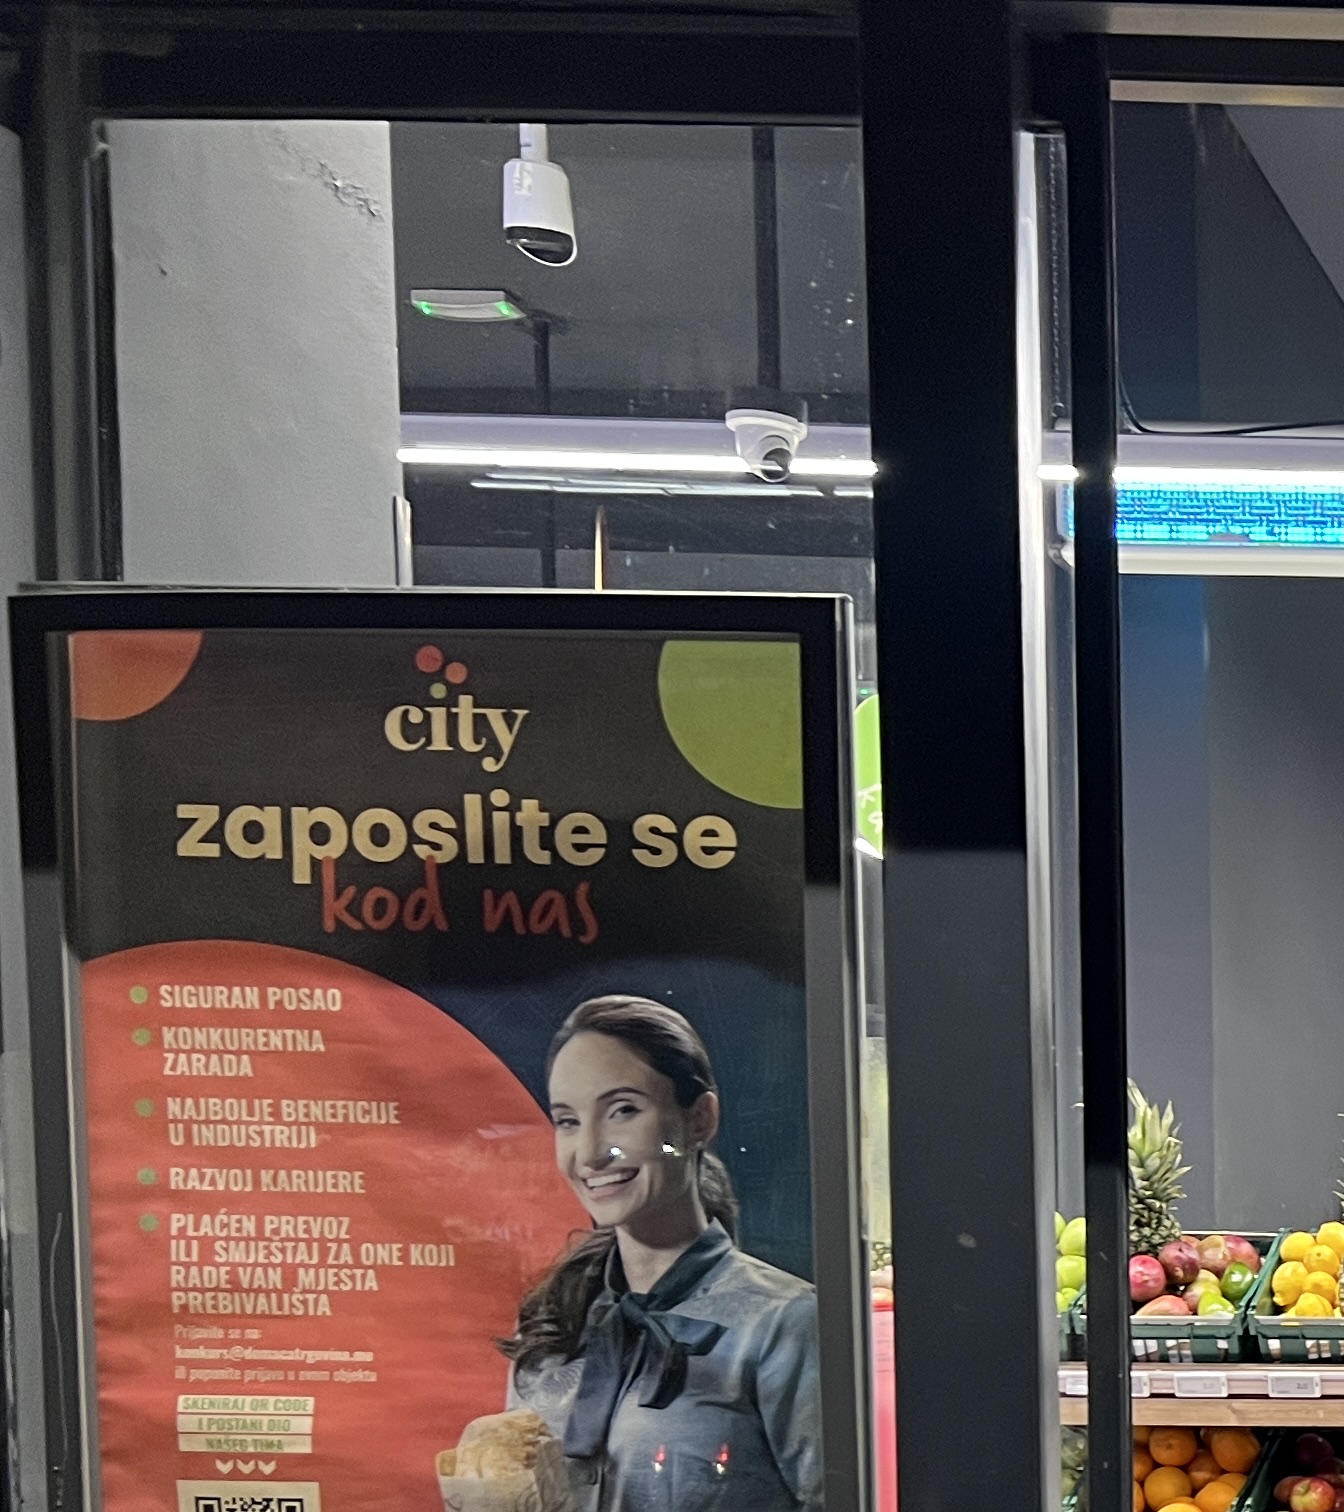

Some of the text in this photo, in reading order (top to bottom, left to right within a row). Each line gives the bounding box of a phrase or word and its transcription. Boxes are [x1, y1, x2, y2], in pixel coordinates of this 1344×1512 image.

[383, 688, 530, 772] city
[175, 790, 739, 885] zaposlite se
[321, 853, 600, 944] kod nas
[159, 984, 342, 1012] SIGURAN POSAO
[161, 1026, 325, 1053] KONKURENTNA
[162, 1052, 254, 1078] ZARADA
[166, 1097, 400, 1124] NAJBOLJE BENEFICIJE
[168, 1123, 317, 1149] U INDUSTRIJI
[169, 1167, 366, 1194] RAZVOJ KARIJERE
[170, 1208, 350, 1240] PLAĆEN PREVOZ
[170, 1234, 455, 1267] ILI SMJEŠTAJ ZA ONE KOJI
[170, 1265, 379, 1292] RADE VAN MJESTA
[171, 1287, 333, 1316] PREBIVALIŠTA
